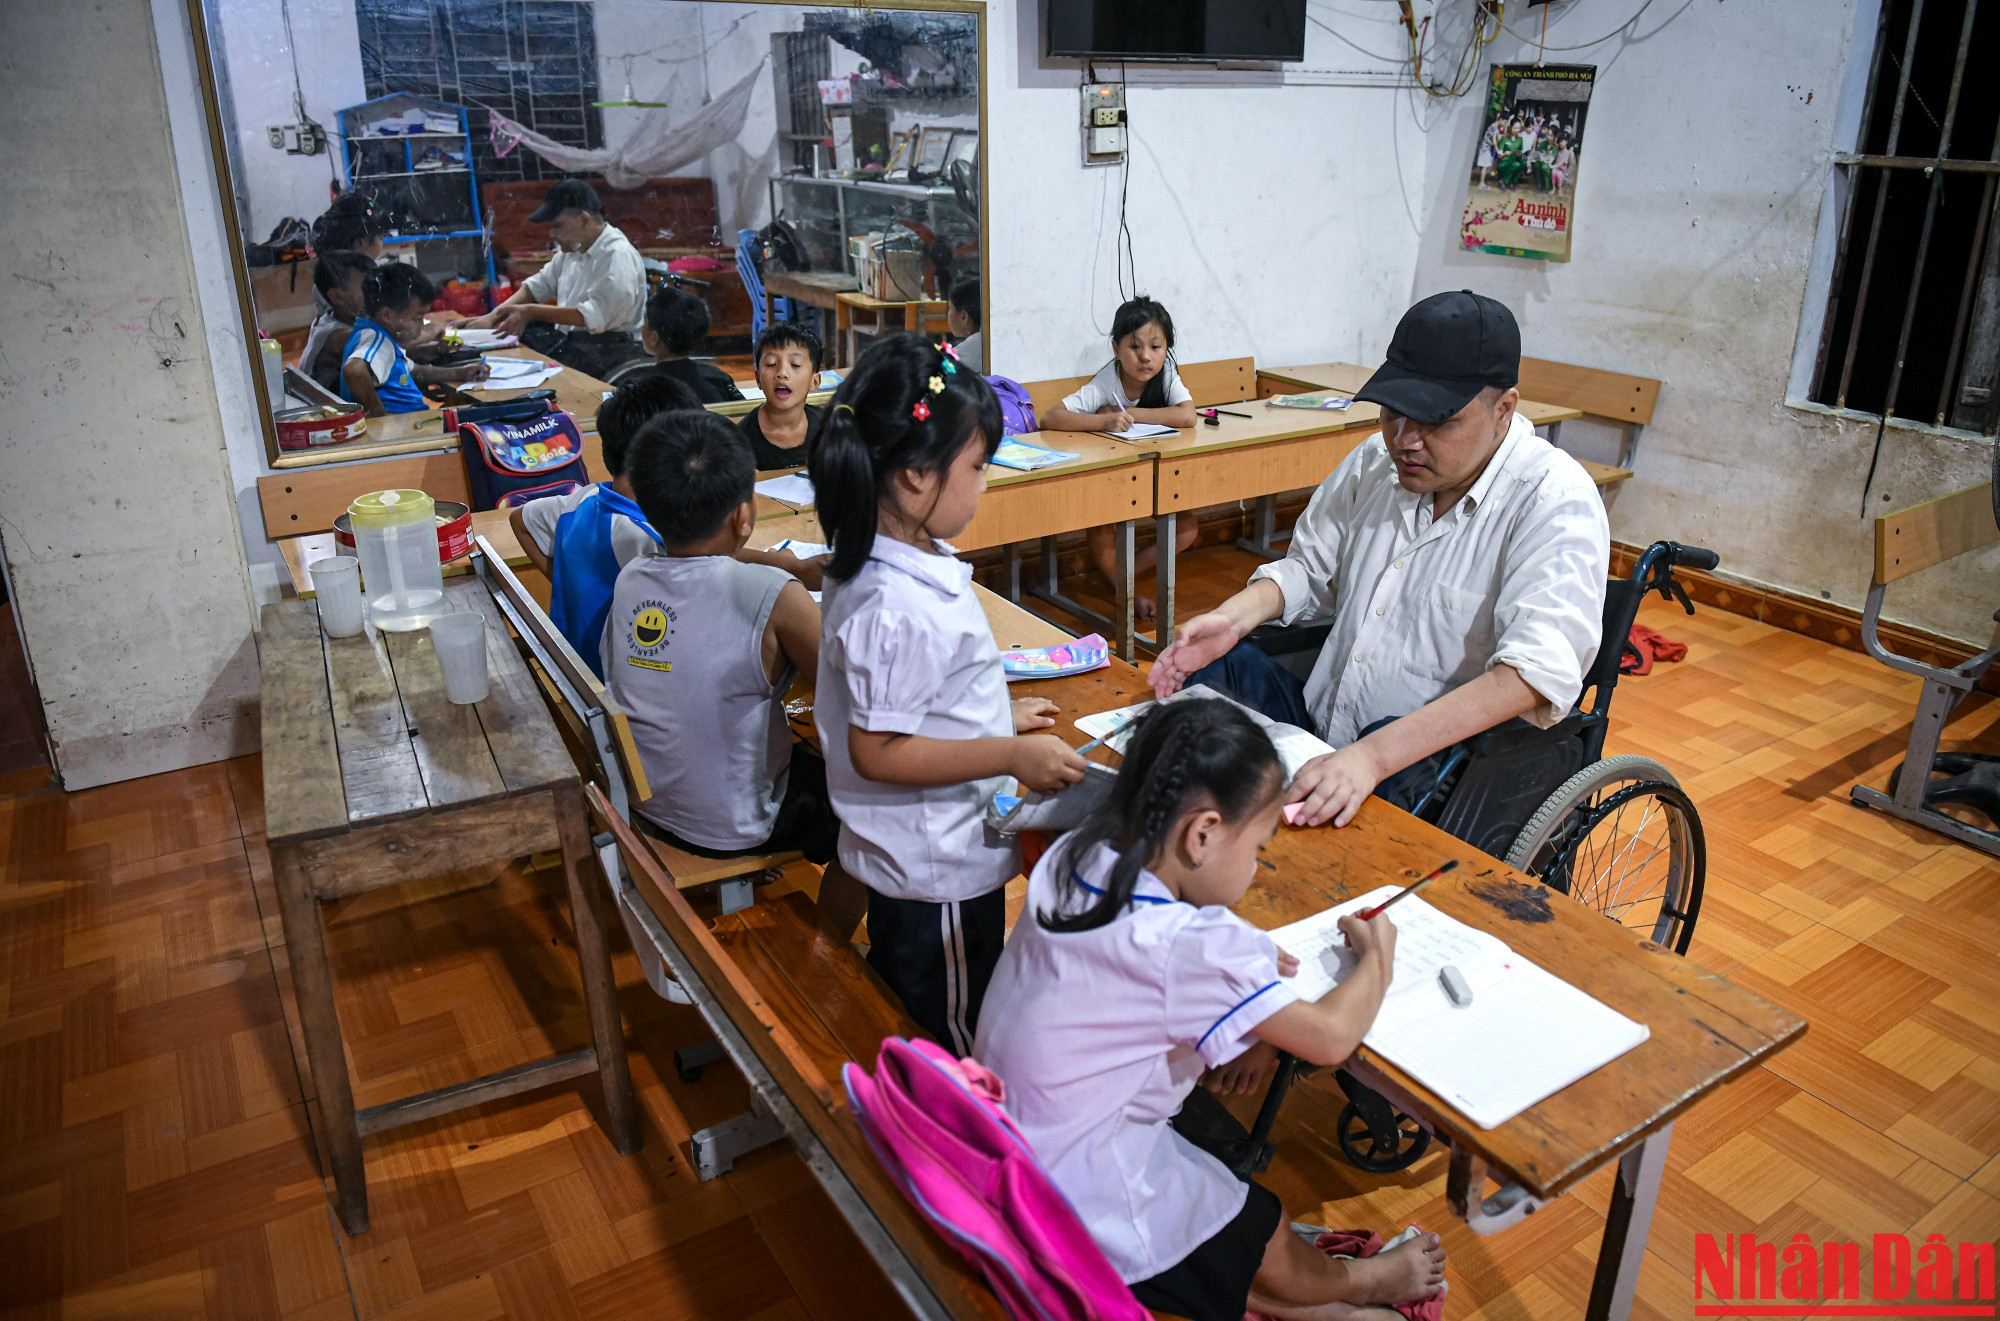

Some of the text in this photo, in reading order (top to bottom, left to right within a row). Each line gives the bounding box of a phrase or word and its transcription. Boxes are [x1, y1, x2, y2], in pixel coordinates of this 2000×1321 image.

[502, 418, 559, 440] VINAMILK
[632, 599, 678, 623] BE FEARLESS
[627, 633, 670, 657] BE FEARLESS
